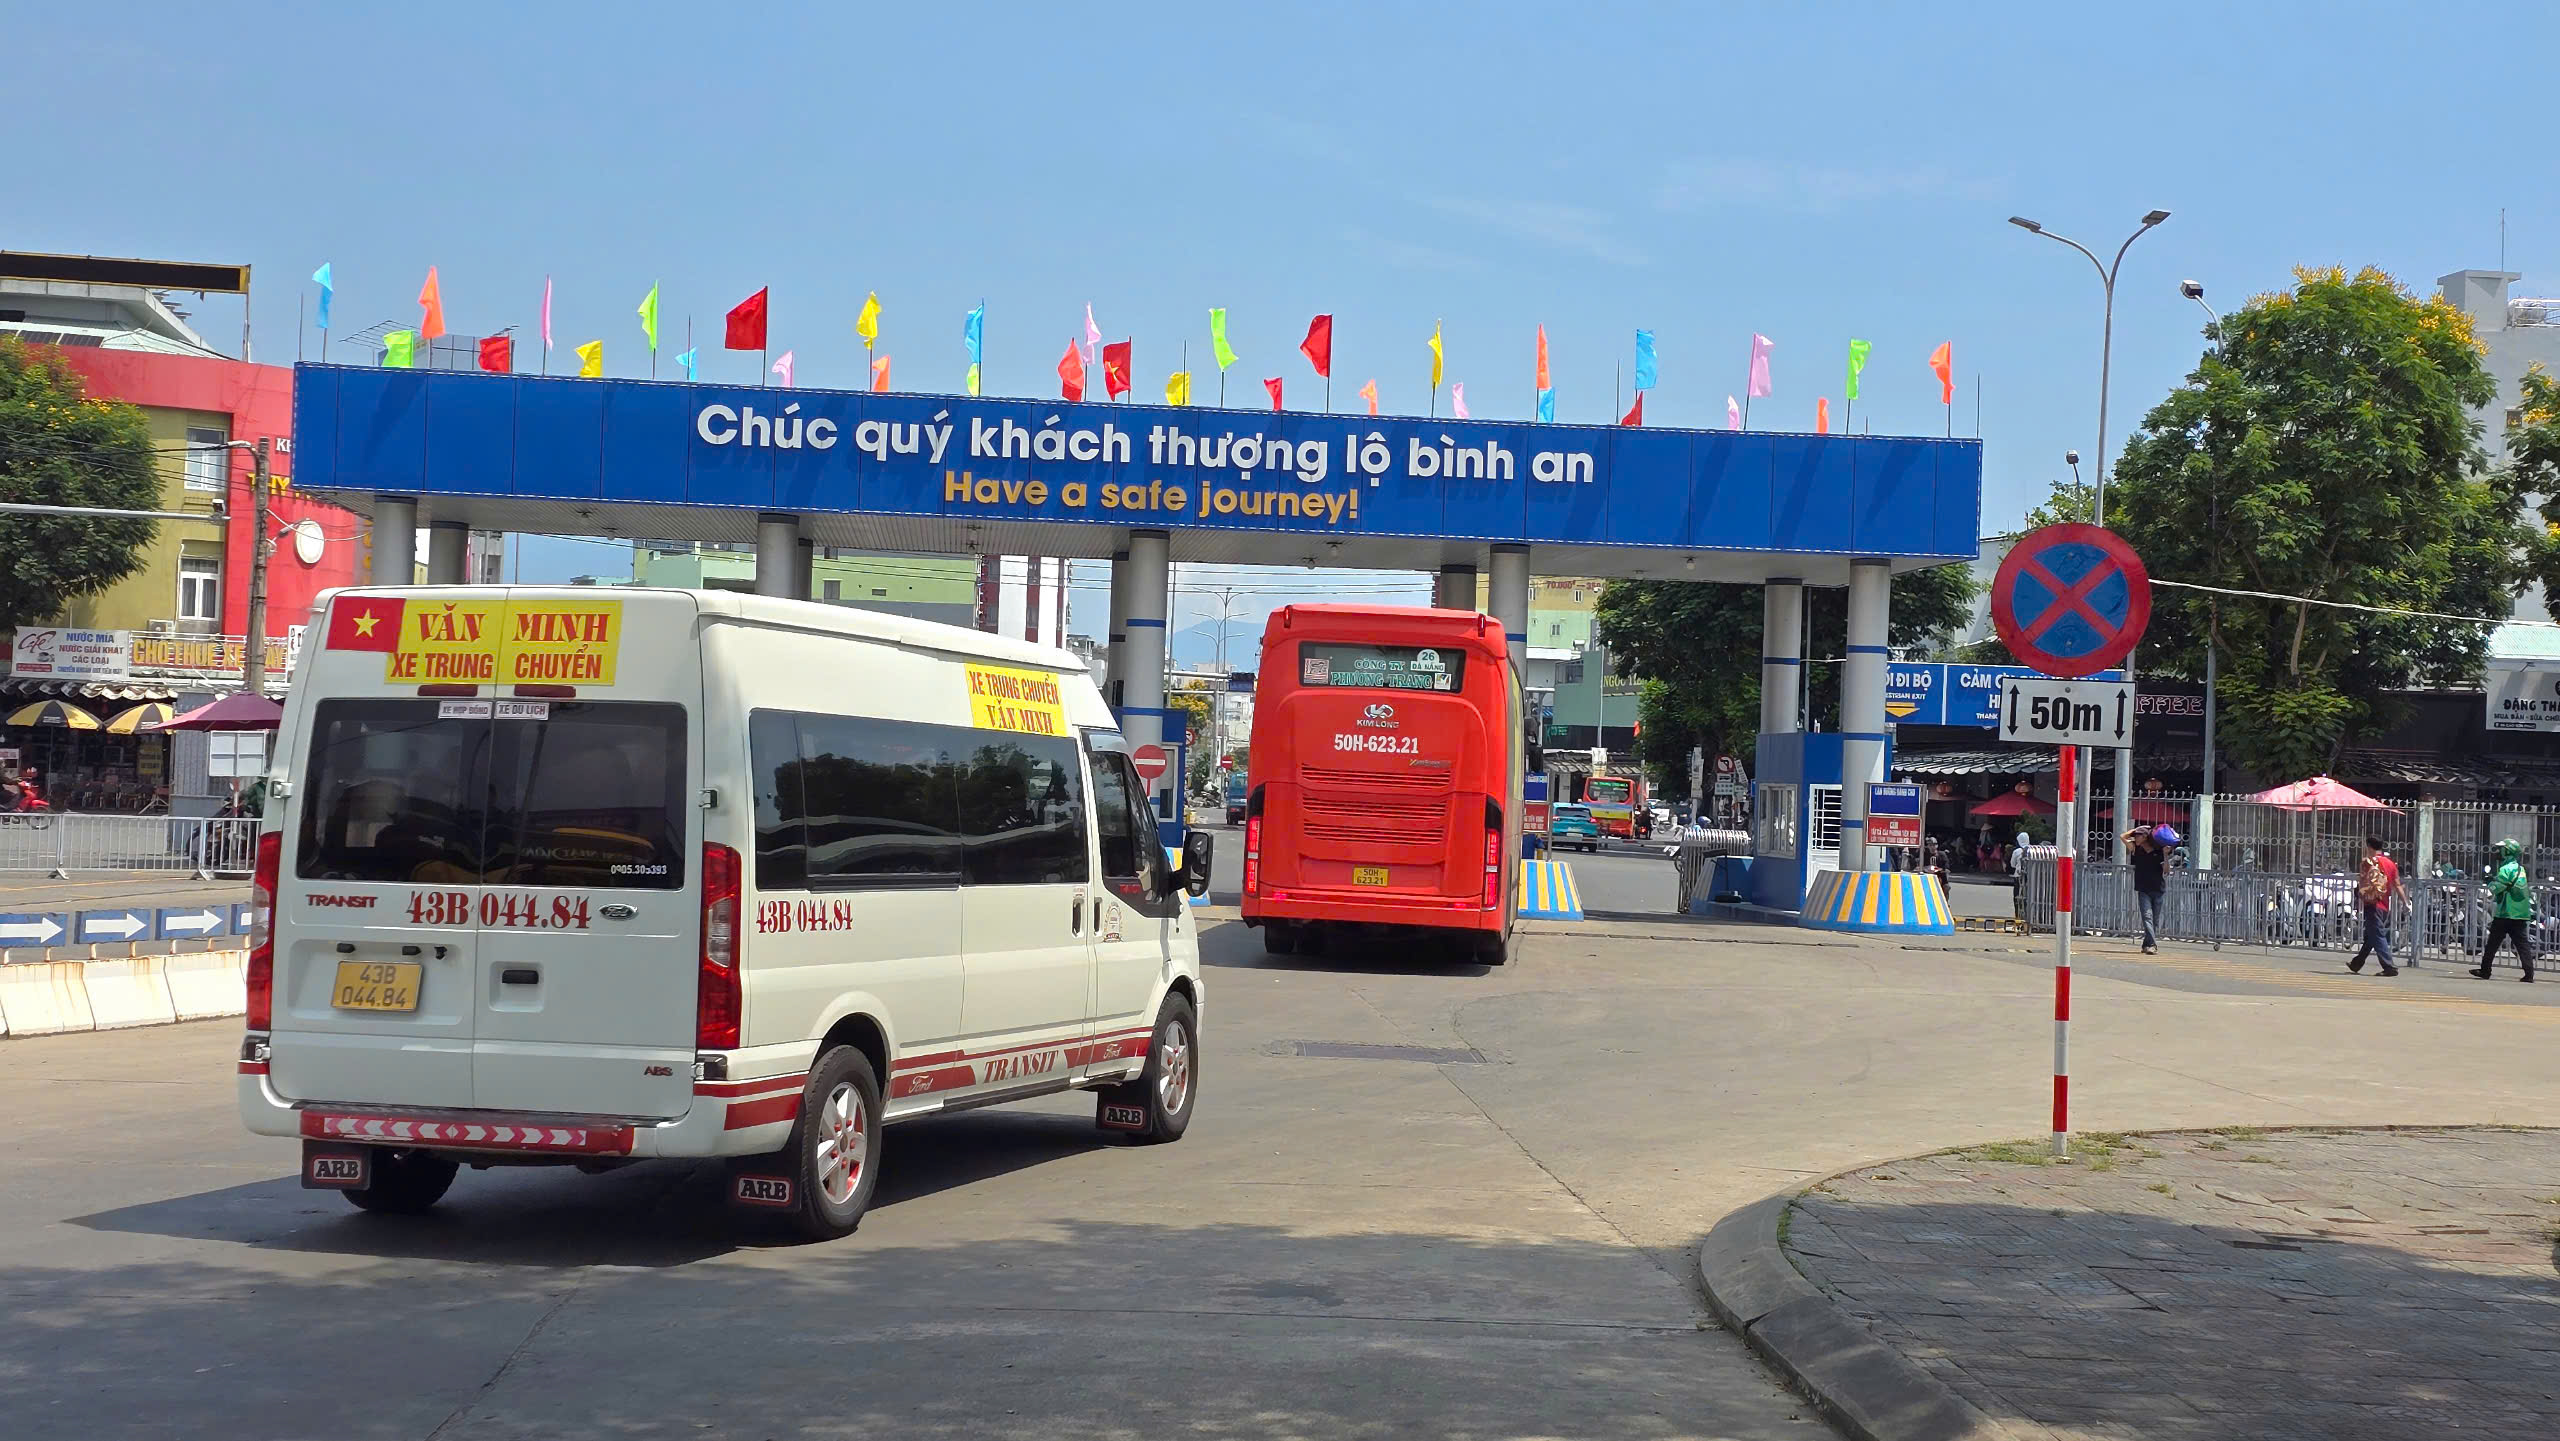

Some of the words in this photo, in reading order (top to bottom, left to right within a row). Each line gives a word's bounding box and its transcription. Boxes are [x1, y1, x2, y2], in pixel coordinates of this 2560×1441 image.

[697, 402, 838, 450] Chúc
[856, 409, 953, 464] quý
[971, 414, 1131, 464] khách
[1148, 425, 1328, 482] thượng
[1347, 431, 1391, 487] lộ
[1410, 434, 1514, 481] bình
[1532, 451, 1594, 483] an
[945, 471, 1048, 506] Have
[1061, 482, 1087, 508] a
[1101, 477, 1187, 512] safe
[1199, 480, 1358, 525] journey!
[418, 602, 487, 642] VĂN
[512, 613, 611, 643] MINH
[66, 631, 94, 643] NƯỚC
[58, 643, 83, 653] NƯỚC
[132, 638, 169, 665] CHO
[222, 643, 246, 668] XE
[1421, 651, 1435, 661] 26
[390, 652, 418, 678] XE
[424, 653, 494, 679] TRUNG
[514, 643, 603, 679] CHUYỂN
[1354, 658, 1386, 670] CÔNG
[1389, 661, 1405, 671] TY
[968, 671, 985, 696] XE
[985, 673, 1021, 700] TRUNG
[1021, 673, 1060, 705] CHUYỂN
[1330, 670, 1384, 687] PHƯƠNG
[1388, 673, 1433, 689] TRANG
[1895, 672, 1910, 688] ĐI
[1912, 670, 1932, 691] BỘ
[1960, 668, 1992, 689] CẢM
[499, 704, 510, 714] XE
[512, 704, 524, 715] DU
[526, 705, 546, 718] LỊCH
[2030, 696, 2102, 732] 50m
[2503, 697, 2536, 712] ĐẶNG
[986, 699, 1017, 730] VĂN
[1018, 708, 1055, 735] MINH
[1357, 719, 1374, 727] KIM
[1375, 720, 1400, 729] LONG
[1333, 733, 1419, 754] 50H-623.21
[305, 894, 379, 909] TRANSIT
[405, 890, 469, 926] 43B
[480, 892, 592, 929] 044.84
[756, 899, 792, 934] 43B
[797, 898, 854, 932] 044.84
[359, 965, 397, 985] 43B
[341, 986, 408, 1008] 044.84
[1102, 1043, 1123, 1060] Ford
[643, 1065, 673, 1077] ABS
[982, 1050, 1059, 1084] TRANSIT
[907, 1075, 934, 1094] Ford
[1106, 1107, 1142, 1125] ARB
[315, 1159, 360, 1180] ARB
[740, 1180, 789, 1202] ARB
